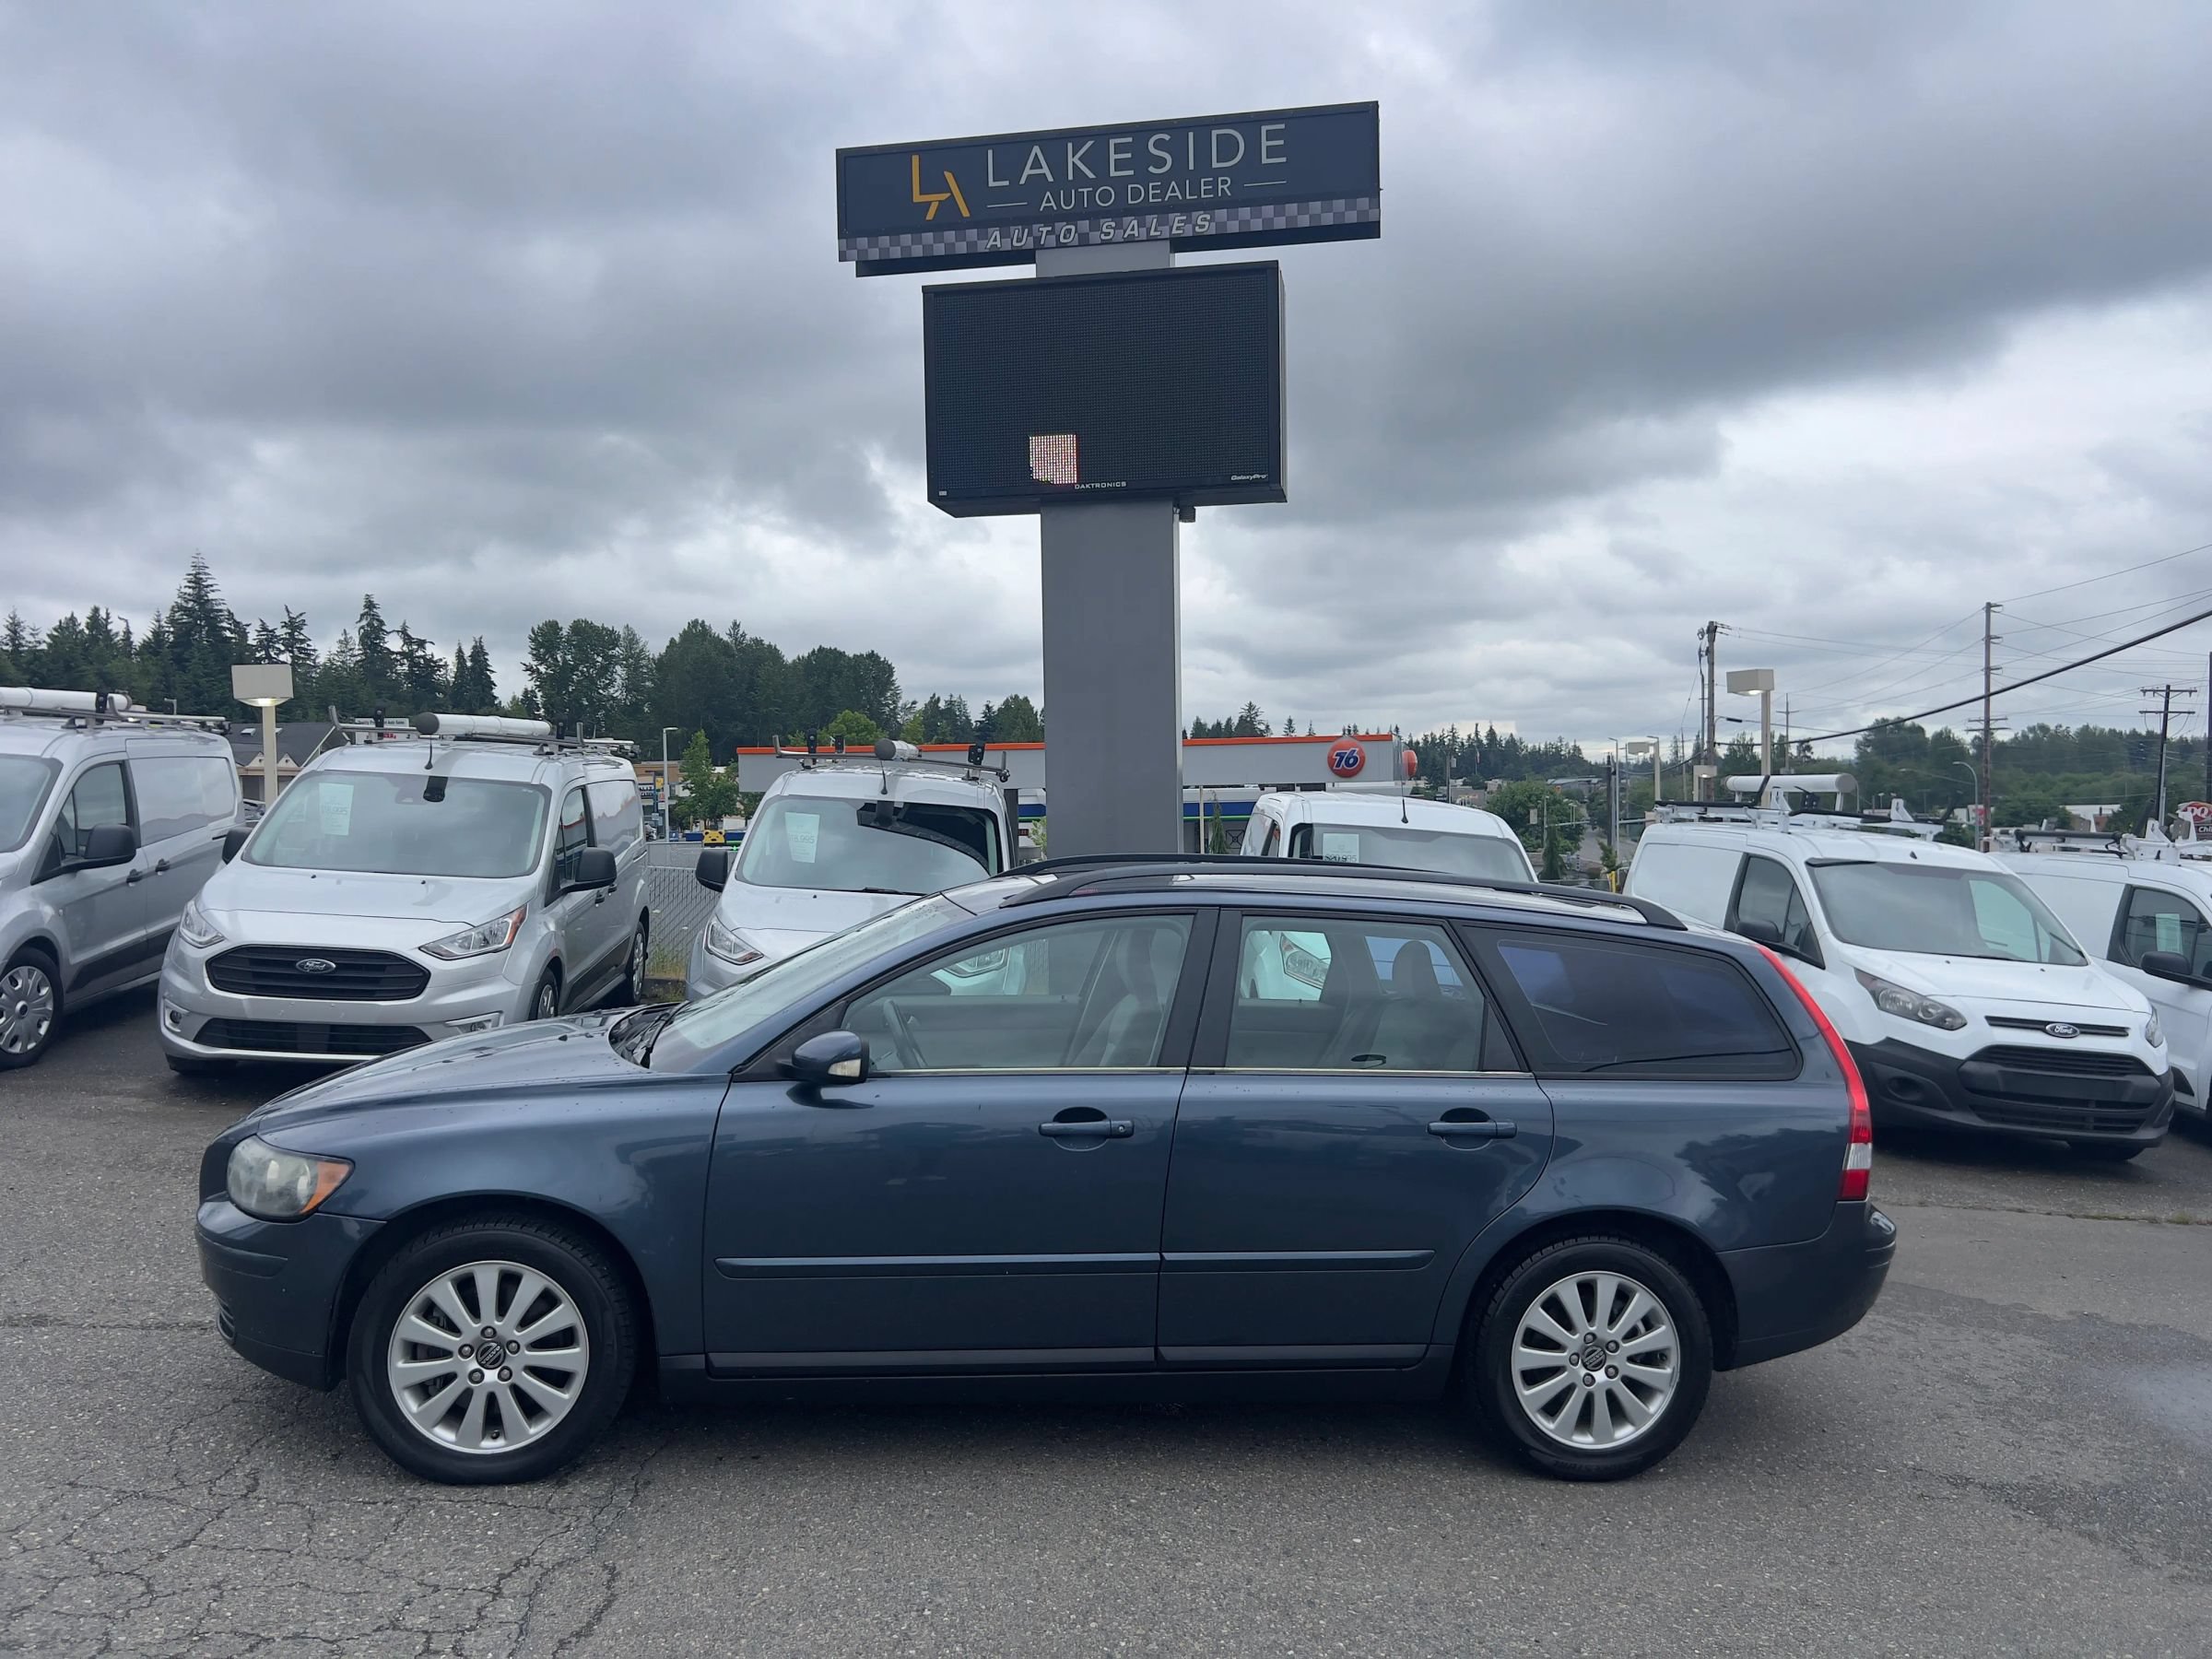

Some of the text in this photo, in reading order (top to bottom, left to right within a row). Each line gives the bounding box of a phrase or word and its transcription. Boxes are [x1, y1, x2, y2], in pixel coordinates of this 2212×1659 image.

[987, 124, 1288, 187] LAKESIDE
[1040, 176, 1231, 211] AUTO DEALER
[986, 214, 1213, 250] AUTO SALES
[1074, 481, 1126, 489] DAKTRONICS
[1333, 747, 1360, 770] 76
[2186, 806, 2209, 818] DQ
[304, 960, 325, 971] Ford
[481, 1346, 500, 1364] VOLVO
